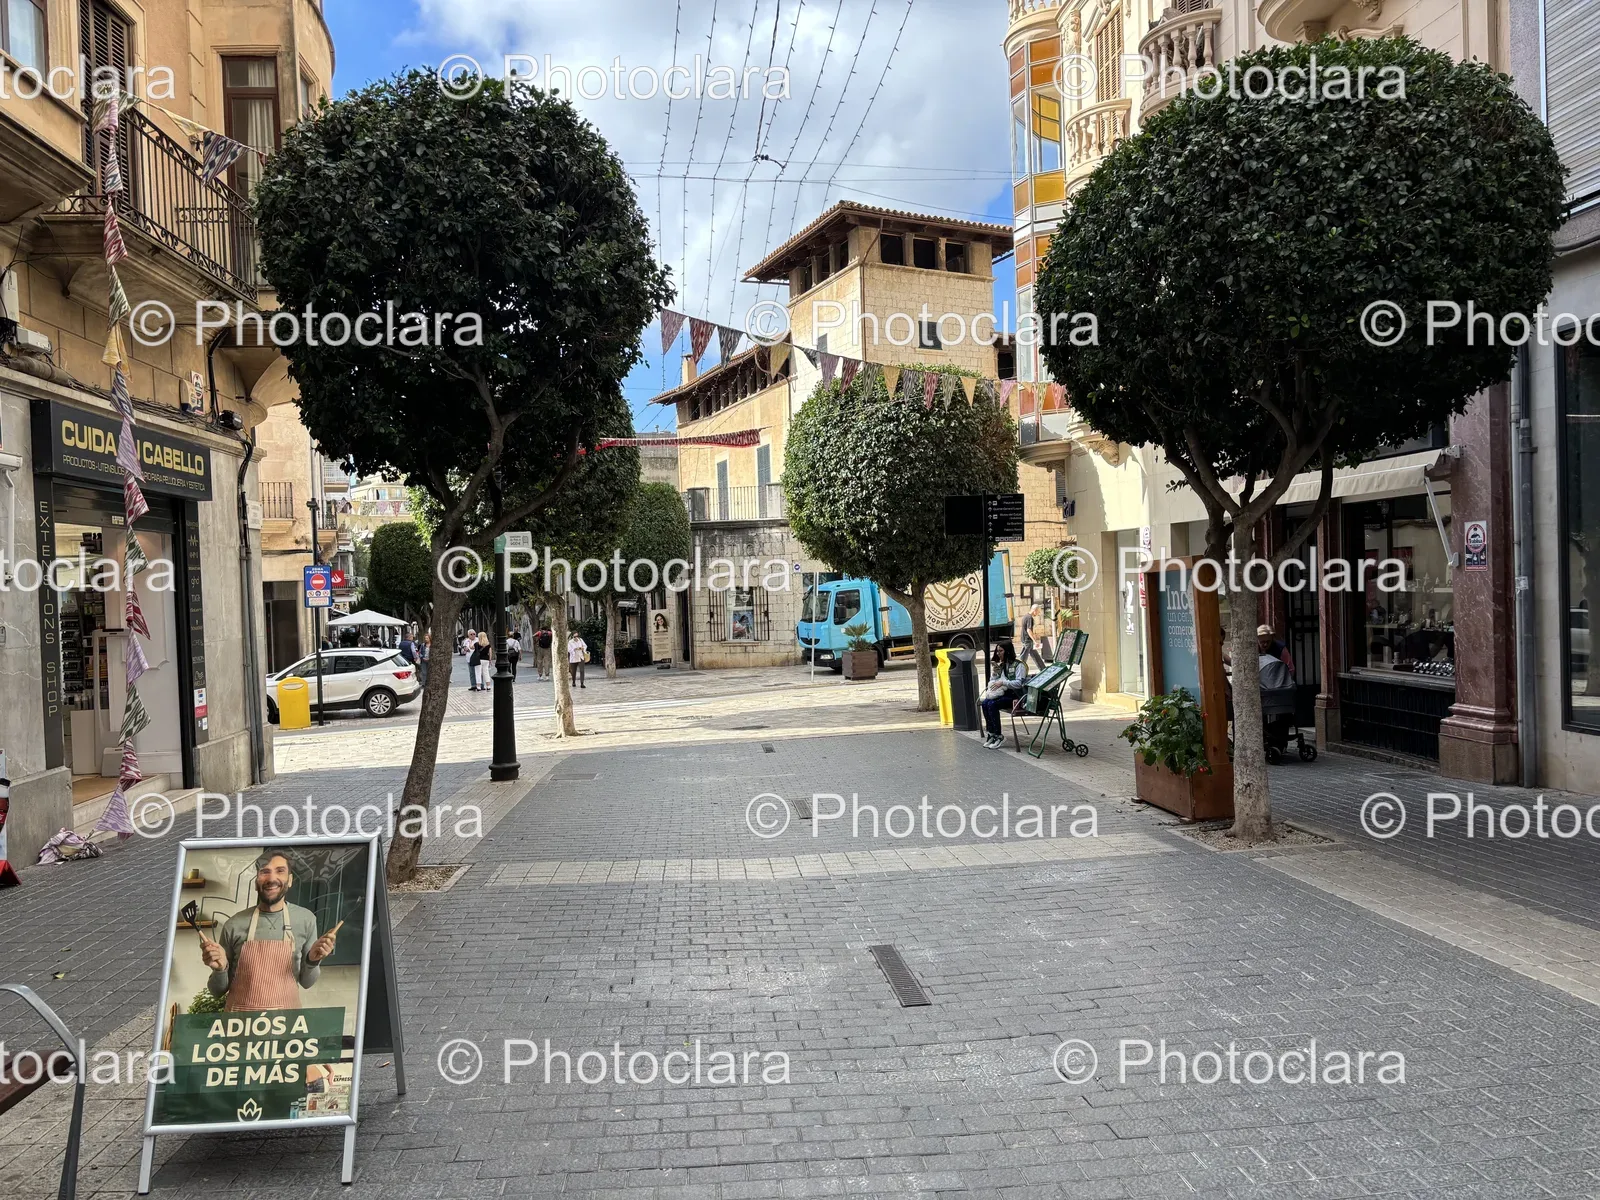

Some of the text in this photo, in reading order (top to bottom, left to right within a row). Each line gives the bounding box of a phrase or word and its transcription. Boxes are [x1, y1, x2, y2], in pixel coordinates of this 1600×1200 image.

[62, 420, 117, 456] CUIDA
[143, 441, 204, 476] CABELLO
[39, 500, 58, 717] EXTENSIONS SHOP
[926, 614, 948, 626] HOPPY
[951, 610, 970, 626] LAGER
[207, 1012, 309, 1038] ADIÓS A
[192, 1038, 319, 1063] LOS KILOS
[206, 1060, 300, 1087] DE MÁS
